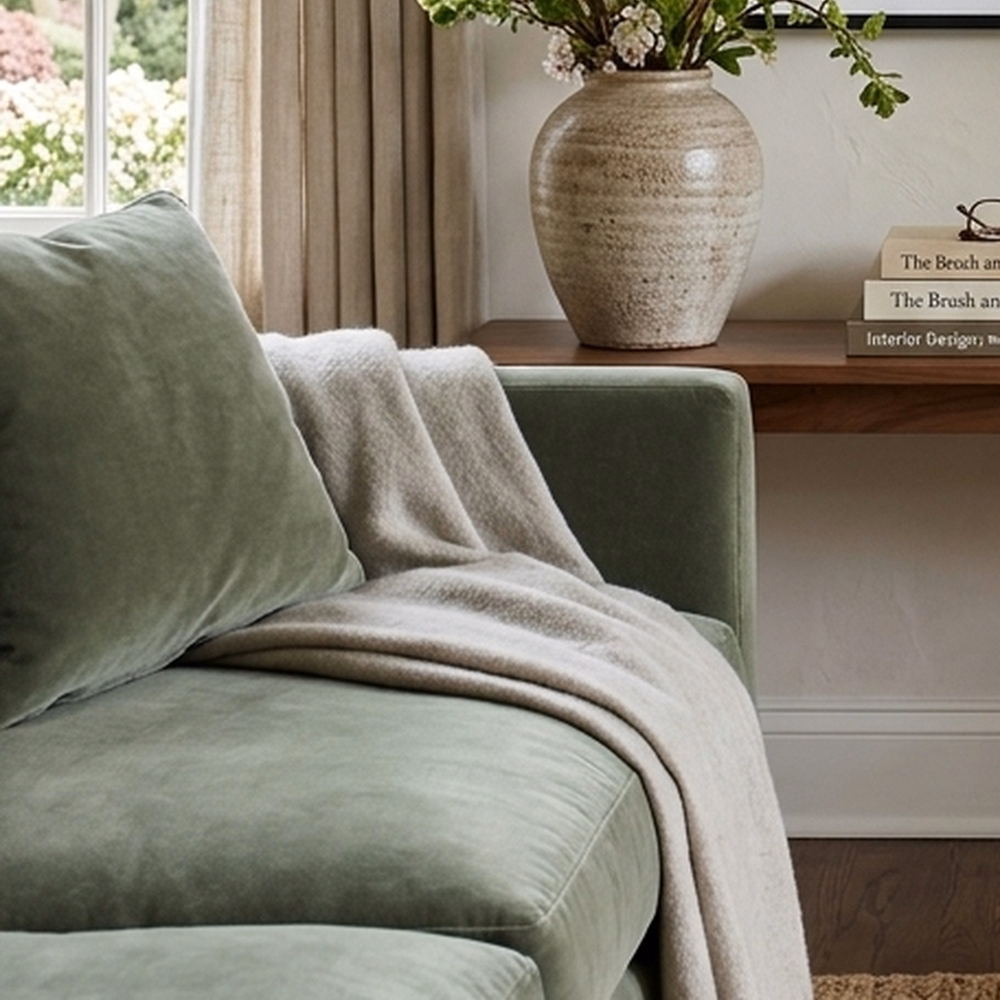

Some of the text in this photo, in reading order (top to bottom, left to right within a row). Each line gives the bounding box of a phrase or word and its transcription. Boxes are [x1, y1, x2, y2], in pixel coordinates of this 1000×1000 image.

[901, 253, 932, 271] The
[890, 291, 924, 309] The
[928, 291, 976, 309] Brush
[867, 331, 922, 347] Interior
